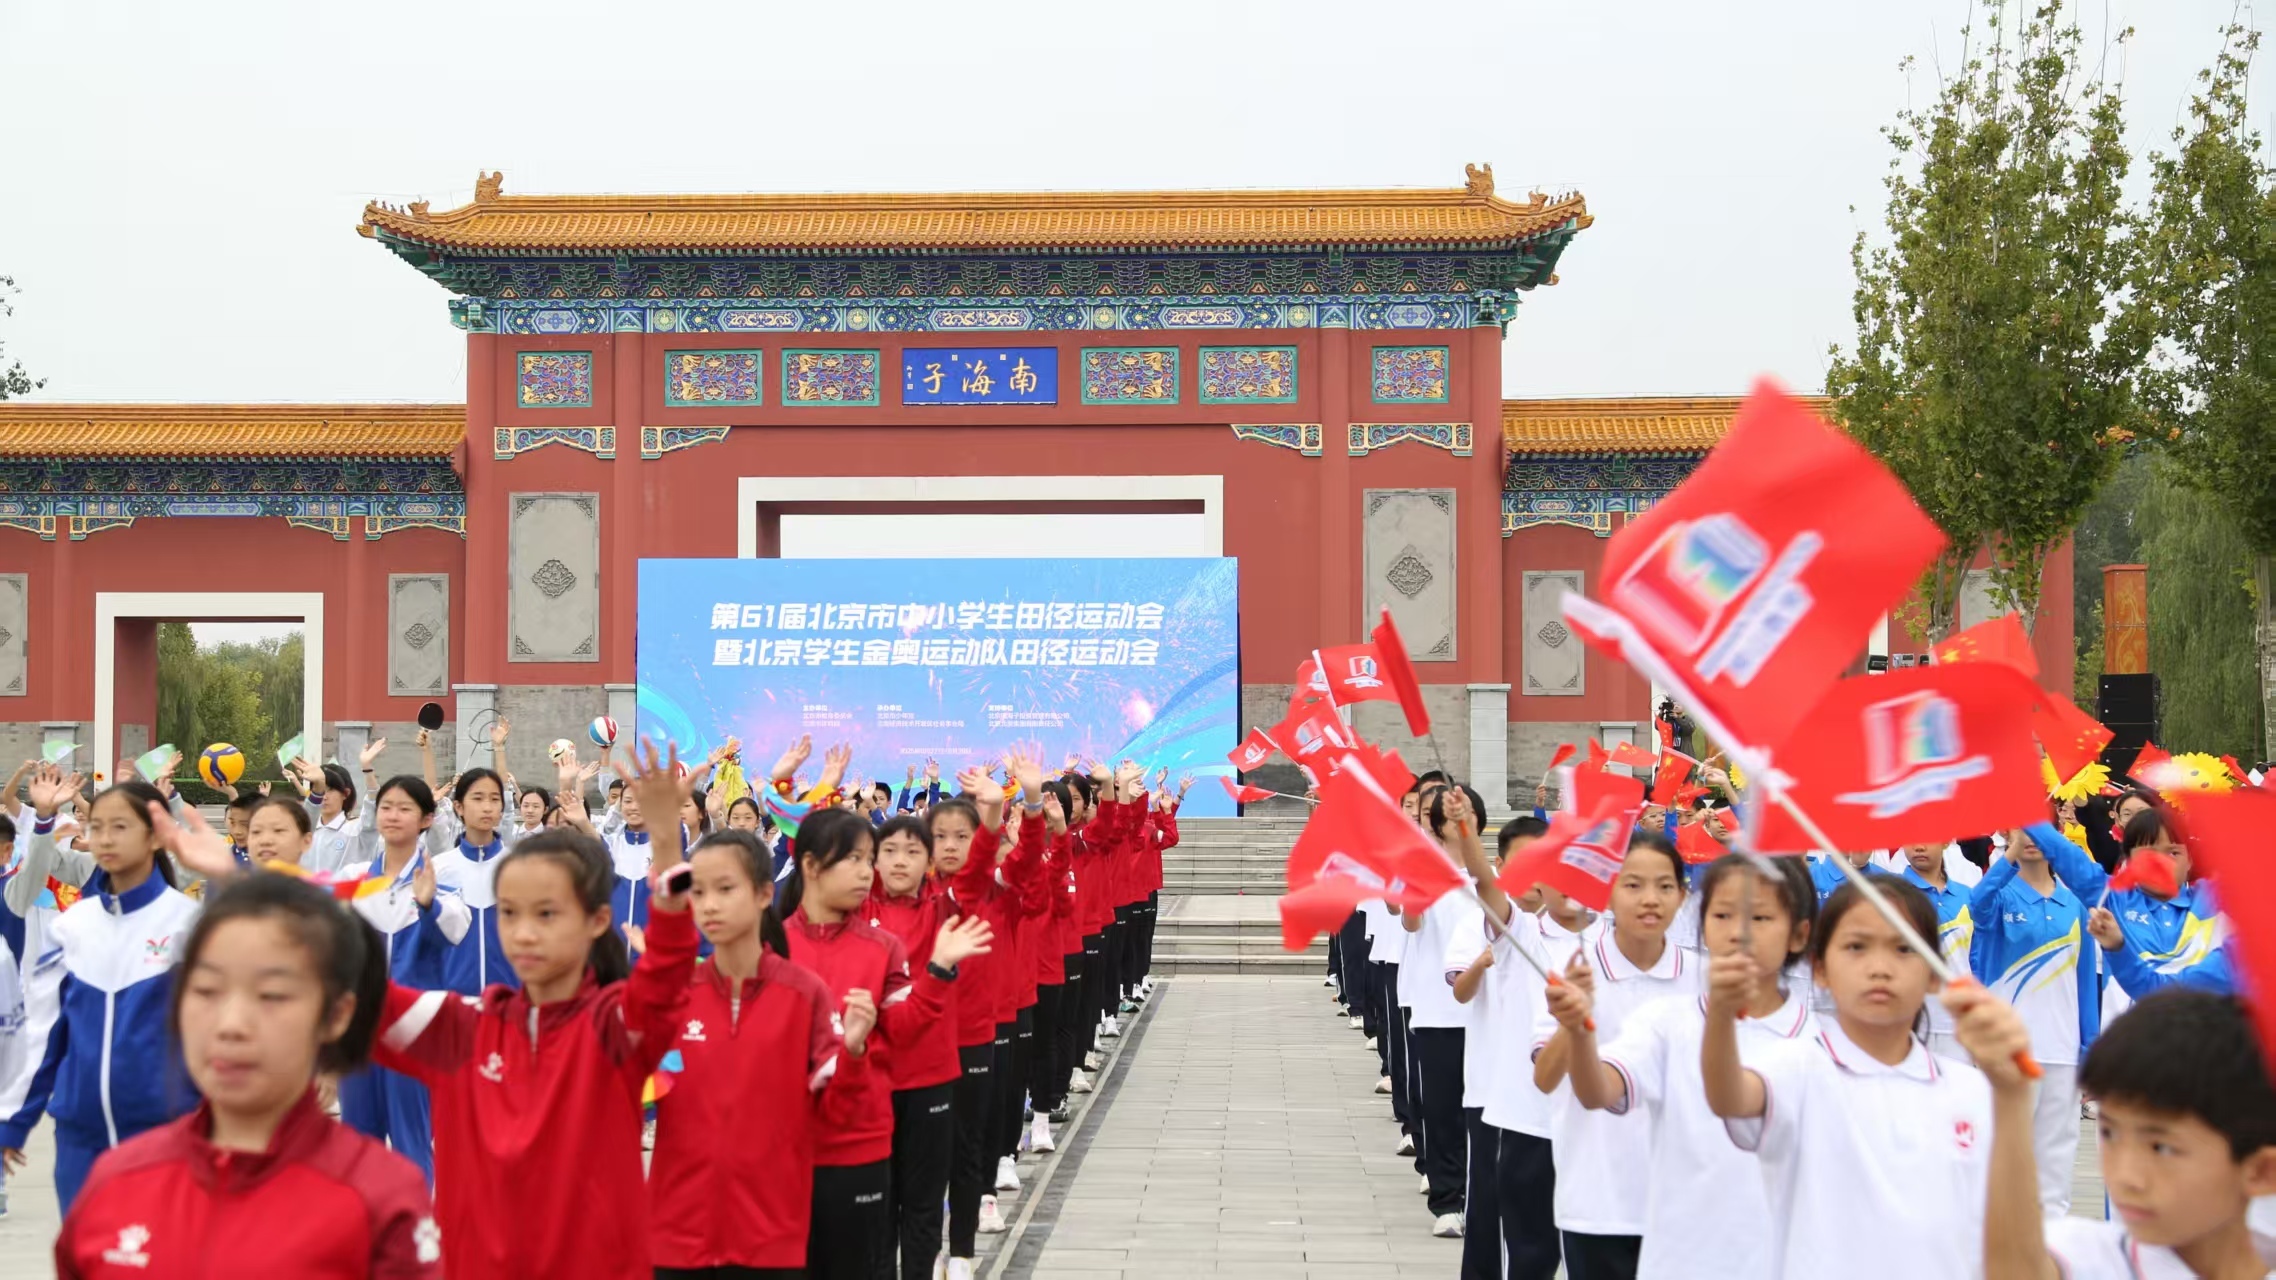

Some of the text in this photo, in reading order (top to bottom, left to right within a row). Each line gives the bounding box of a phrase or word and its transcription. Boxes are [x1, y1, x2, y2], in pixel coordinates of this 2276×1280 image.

[709, 601, 1165, 630] 第61届北京市中小学生田径运动会
[711, 638, 1160, 666] 暨北京学生金奥运动队田径运动会
